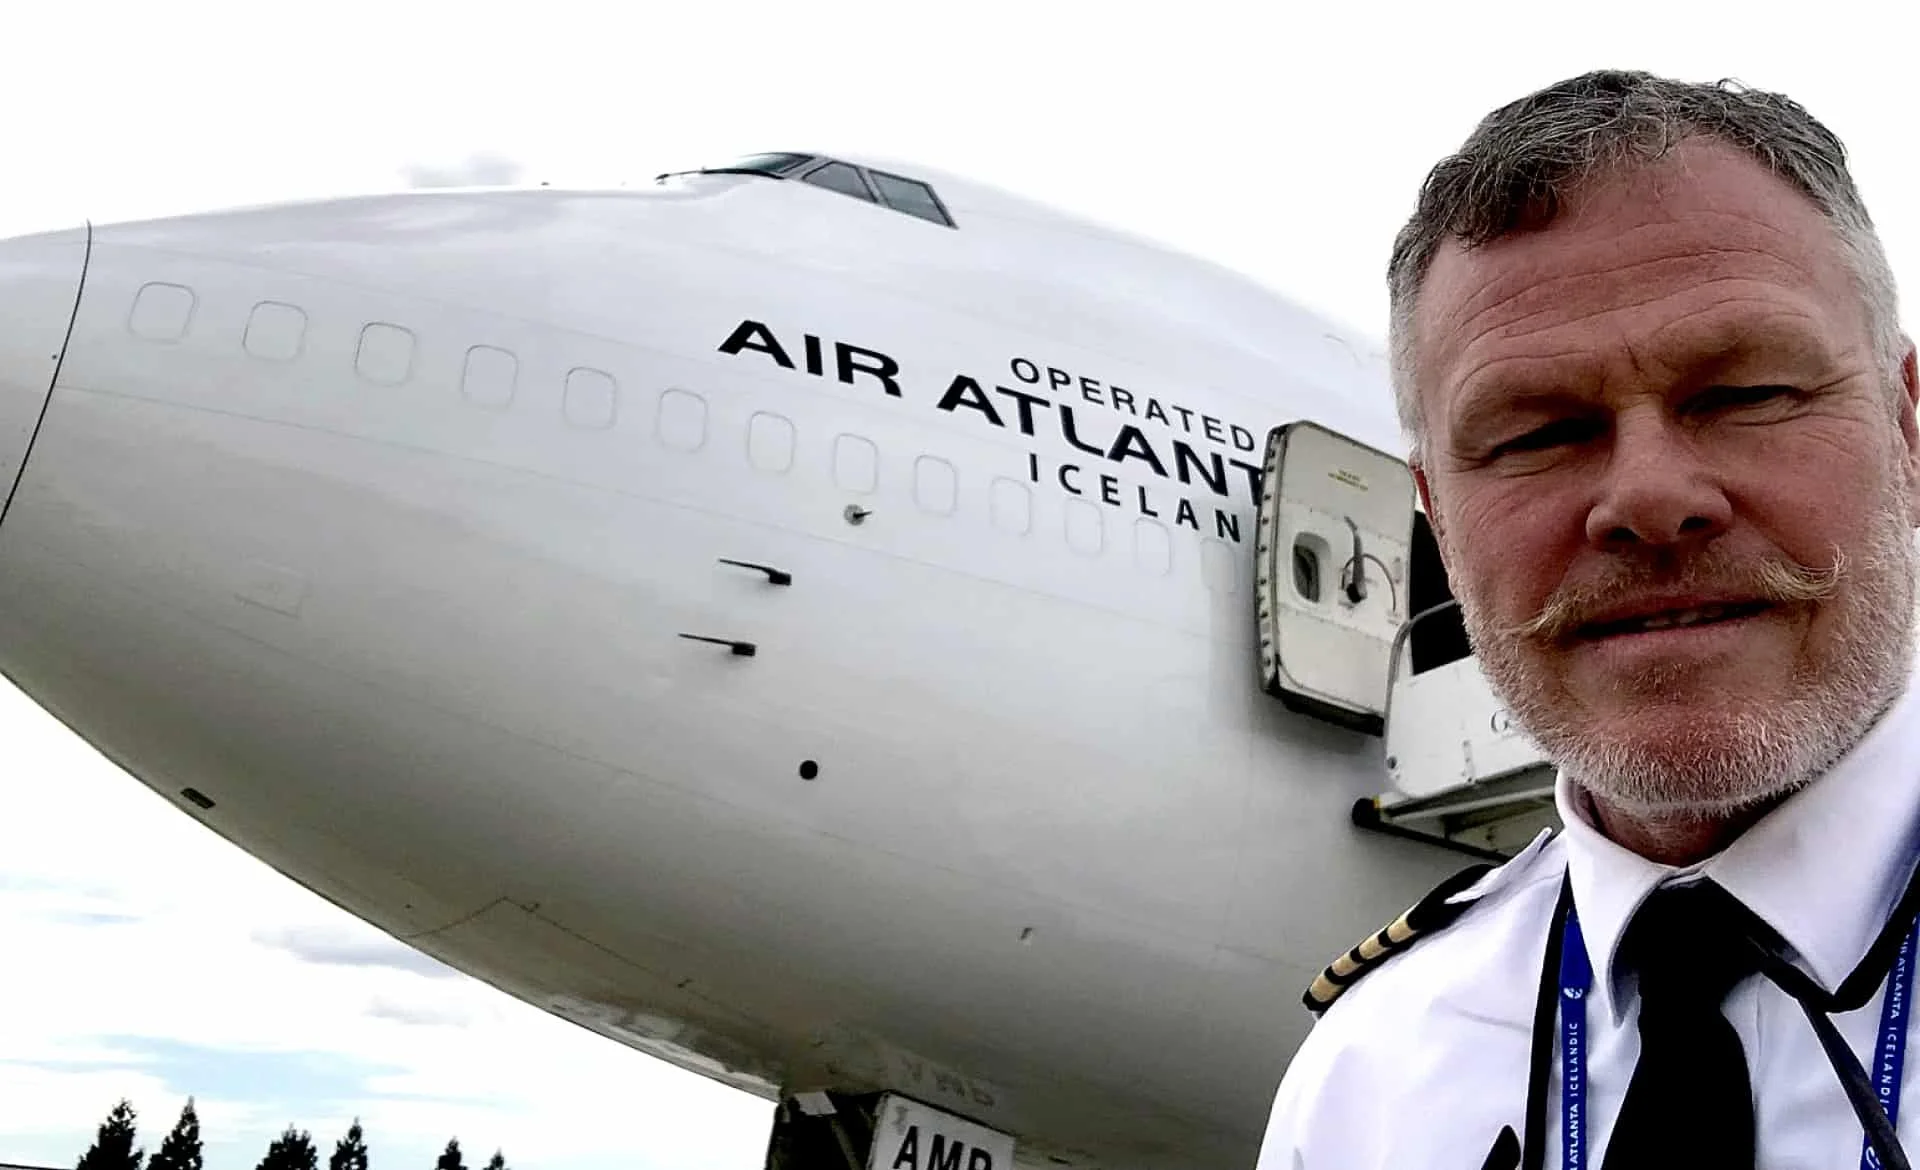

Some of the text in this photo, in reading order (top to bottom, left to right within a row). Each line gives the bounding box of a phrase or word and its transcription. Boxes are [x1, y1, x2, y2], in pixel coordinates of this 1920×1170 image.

[717, 319, 903, 398] AIR
[1011, 358, 1256, 453] OPERATED
[1030, 453, 1241, 543] ICELAN
[1890, 957, 1907, 1020] ATLANTA
[1568, 1022, 1579, 1097] ICELANDIC
[1569, 1102, 1580, 1165] ATLANTA
